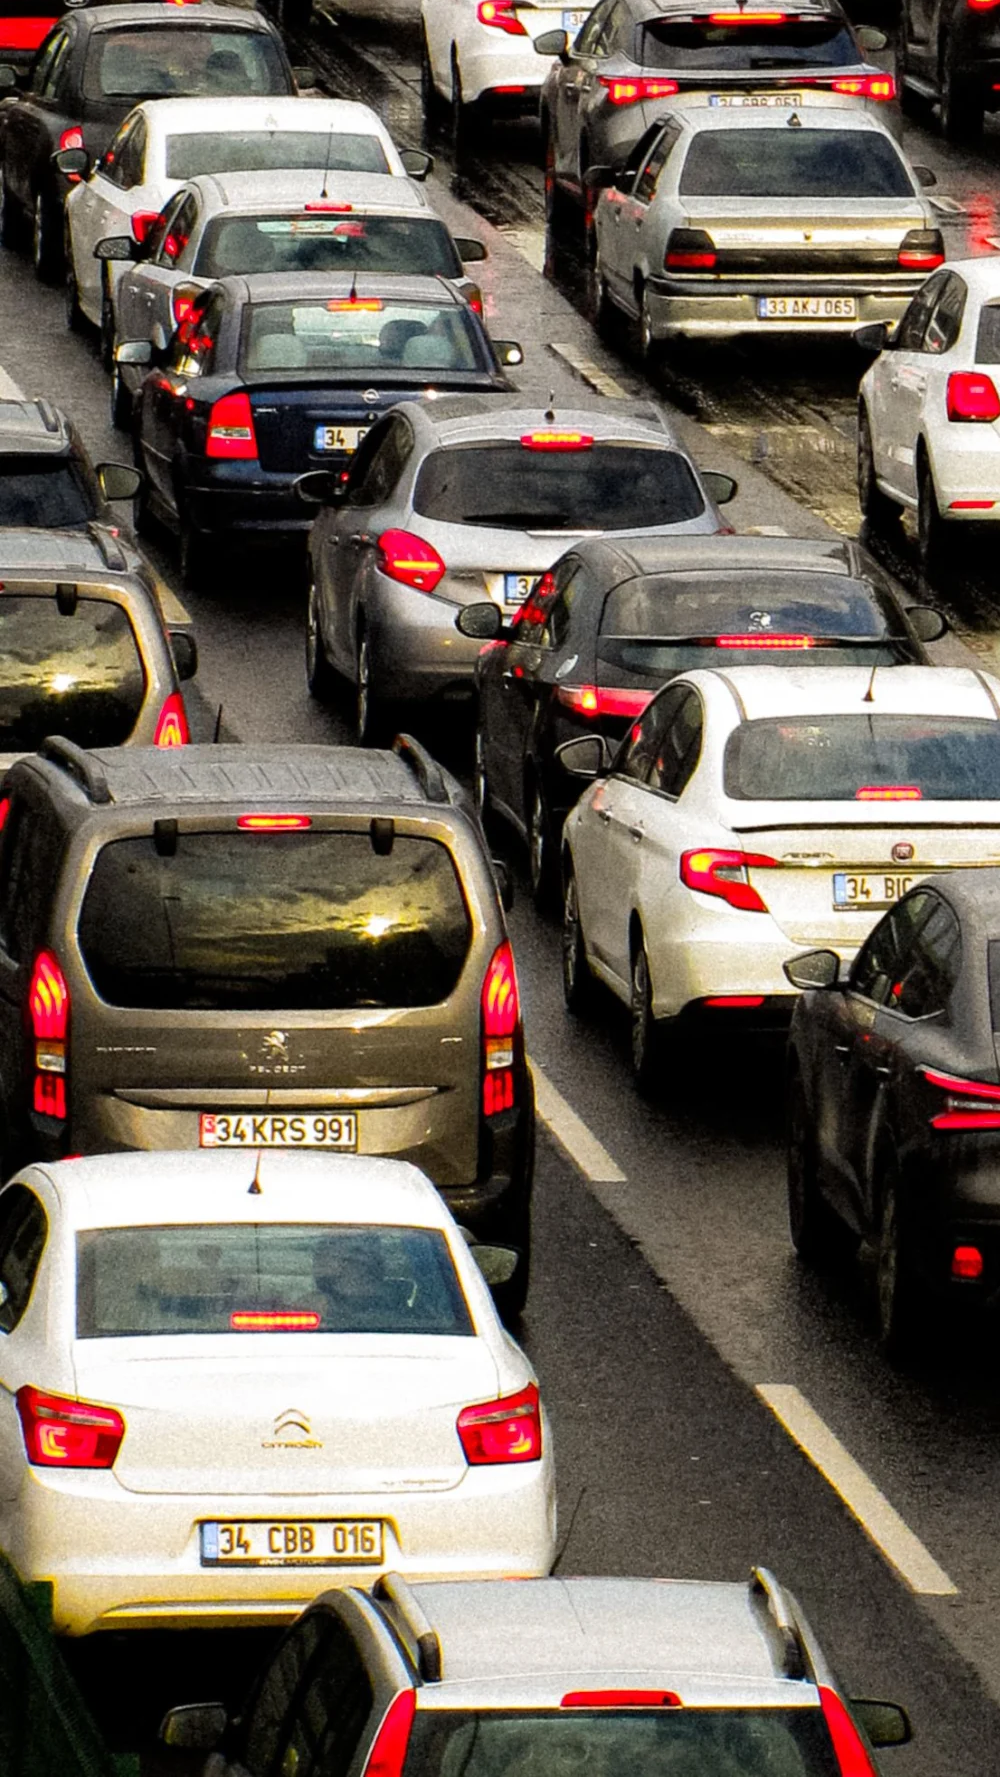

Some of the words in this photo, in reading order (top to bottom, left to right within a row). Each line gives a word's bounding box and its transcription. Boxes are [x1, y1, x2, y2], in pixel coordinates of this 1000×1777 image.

[769, 299, 788, 314] 33
[792, 299, 820, 314] AKJ
[825, 299, 853, 314] 065
[325, 429, 346, 447] 34
[846, 877, 871, 900] 34
[216, 1115, 248, 1143] 34
[252, 1115, 307, 1144] KRS
[312, 1115, 355, 1144] 991
[218, 1521, 251, 1555] 34
[268, 1521, 315, 1554] CBB
[331, 1521, 377, 1554] 016
